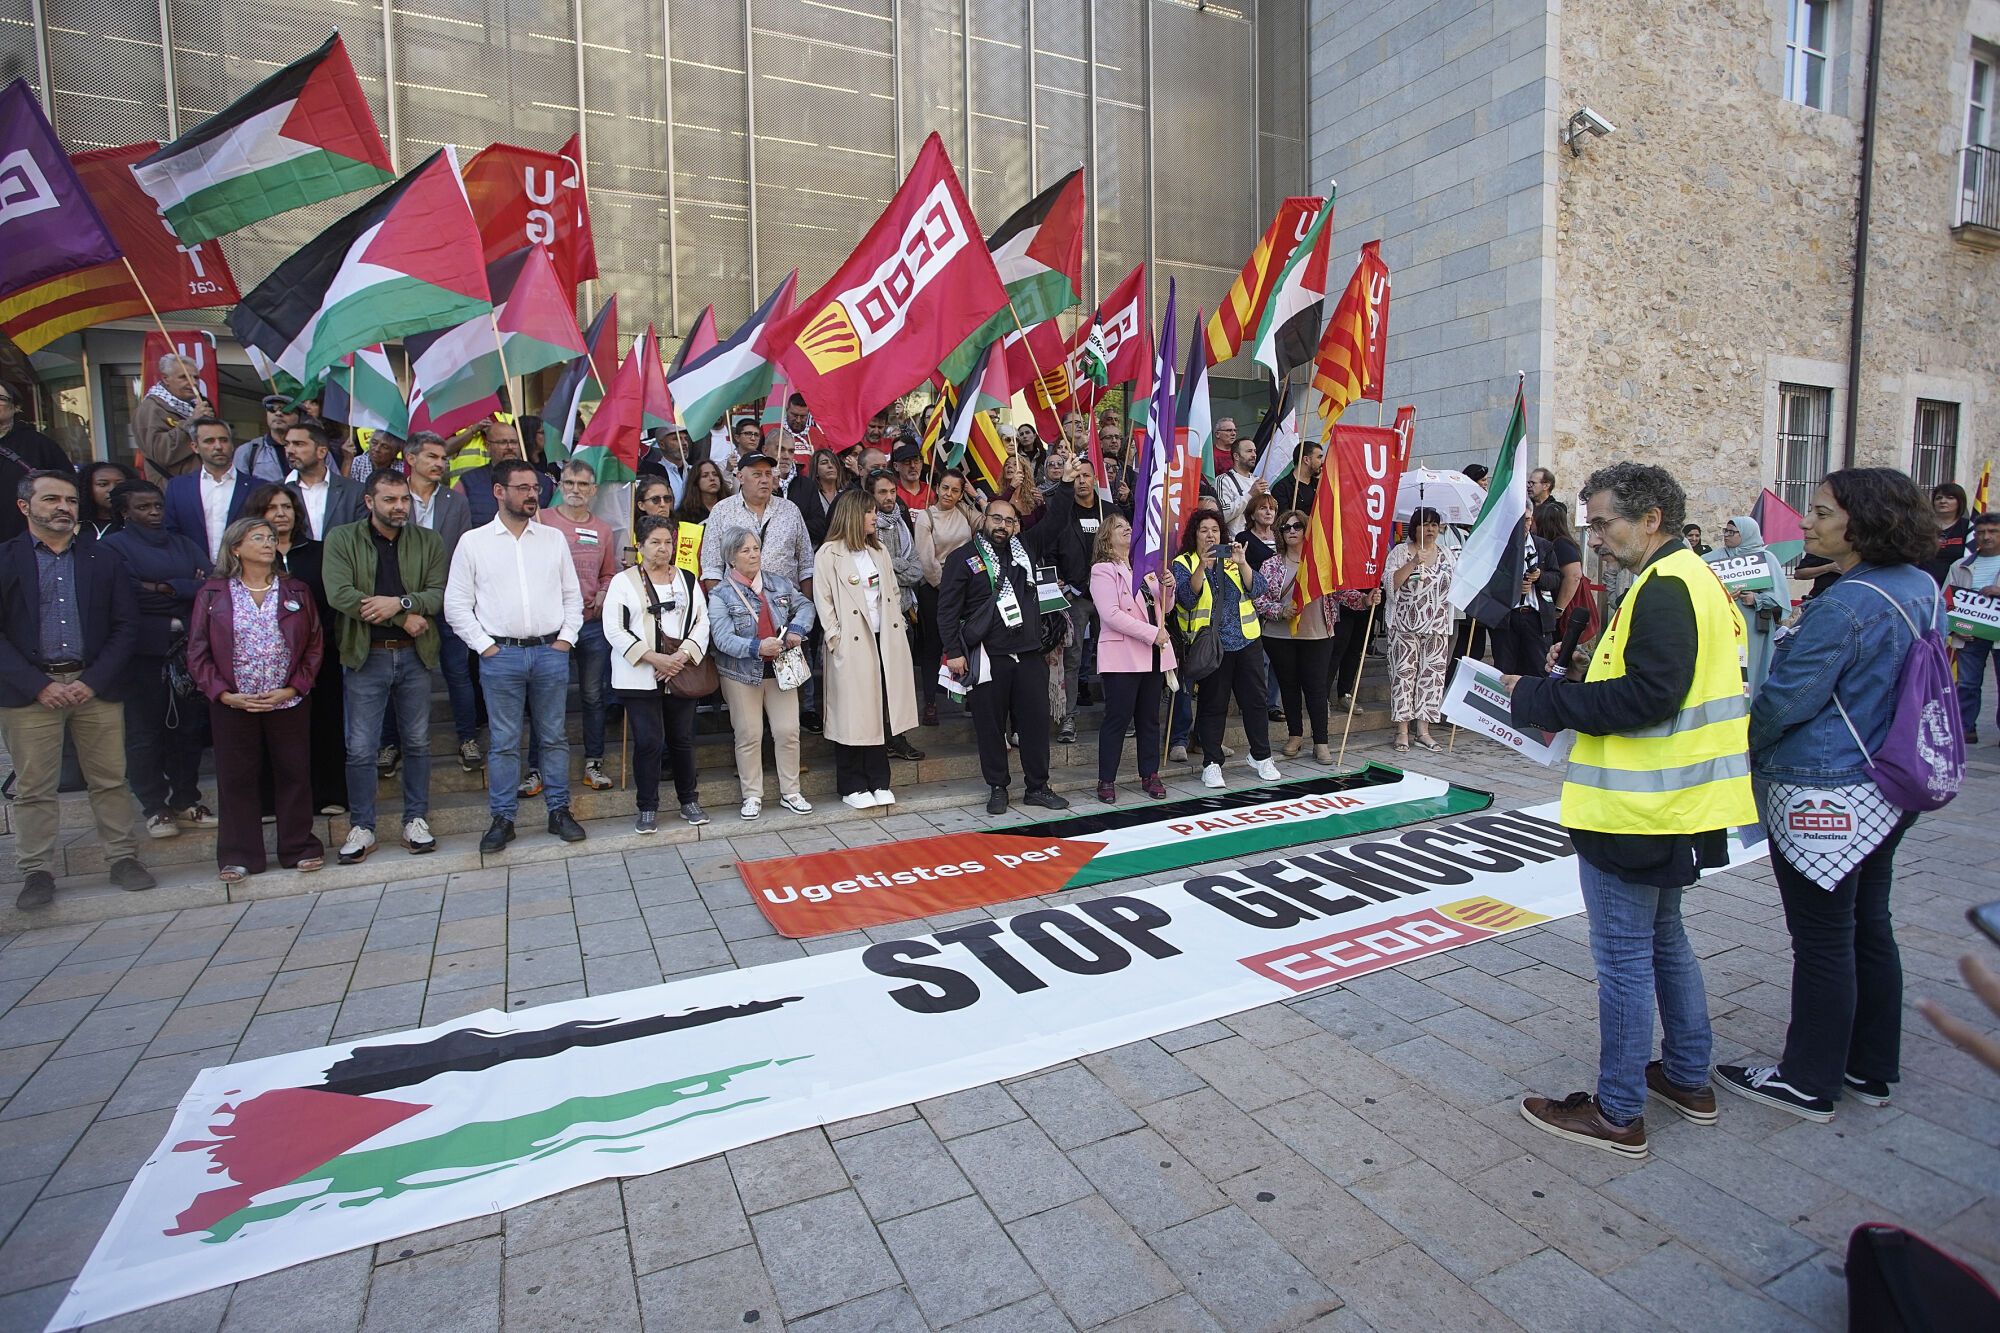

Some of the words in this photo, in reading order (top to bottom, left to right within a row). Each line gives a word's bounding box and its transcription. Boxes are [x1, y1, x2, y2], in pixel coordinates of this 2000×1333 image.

[1709, 555, 1759, 571] STOP
[1719, 568, 1761, 580] ENOCIDIO
[1473, 683, 1511, 709] LESTINA
[1793, 816, 1847, 827] CCOO
[1803, 832, 1847, 840] Palestina
[763, 859, 986, 903] Ugetistes
[994, 845, 1062, 869] per
[1168, 795, 1366, 836] PALESTINA
[862, 896, 1183, 1013] STOP
[1266, 920, 1464, 980] CCOO
